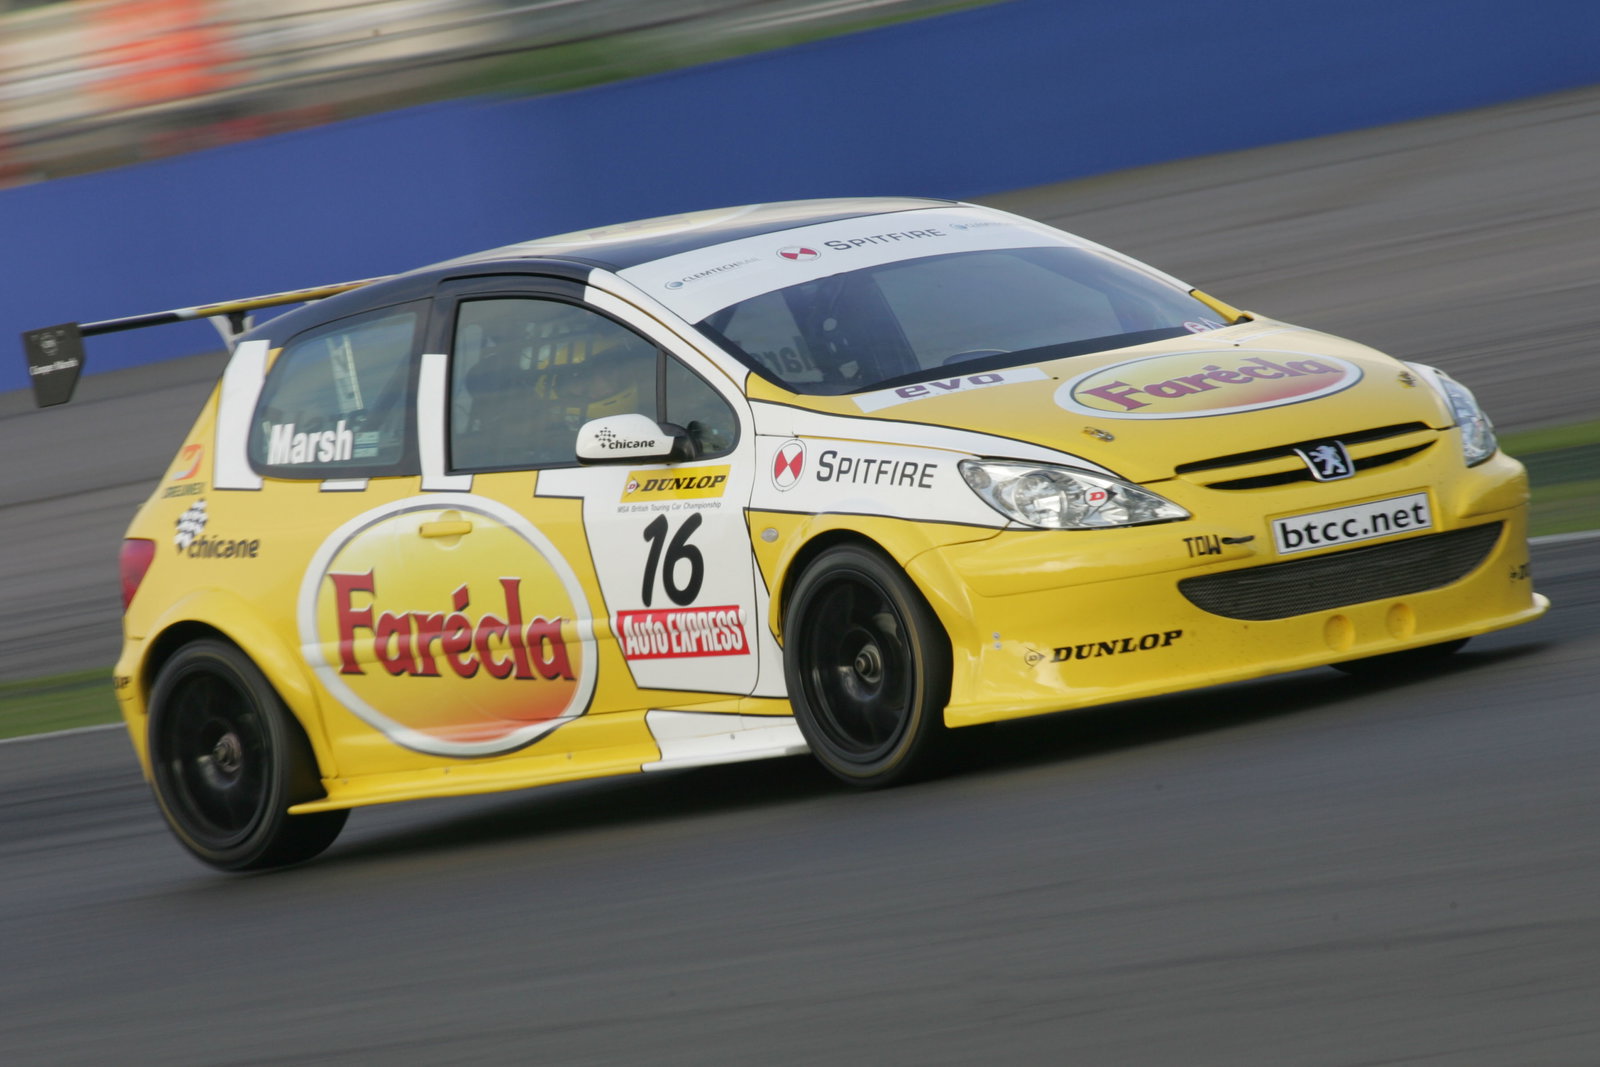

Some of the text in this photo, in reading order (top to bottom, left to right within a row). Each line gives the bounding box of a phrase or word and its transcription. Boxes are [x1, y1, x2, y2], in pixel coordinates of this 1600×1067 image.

[824, 228, 947, 251] SPITFIRE
[895, 373, 1004, 399] evo
[1078, 356, 1345, 411] Farécla
[267, 419, 353, 465] Marsh
[608, 439, 655, 450] chicane
[641, 475, 726, 492] DUNLOP
[816, 450, 938, 489] SPITFIRE
[651, 503, 670, 513] Touring
[672, 502, 681, 511] Car
[683, 501, 721, 511] Championship
[1280, 502, 1426, 549] btcc.net
[187, 535, 260, 558] chicane
[642, 512, 704, 607] 16
[1183, 534, 1222, 558] TOW
[327, 567, 577, 680] Farécla
[622, 609, 744, 656] Auto EXPRESS
[1050, 630, 1183, 663] DUNLOP
